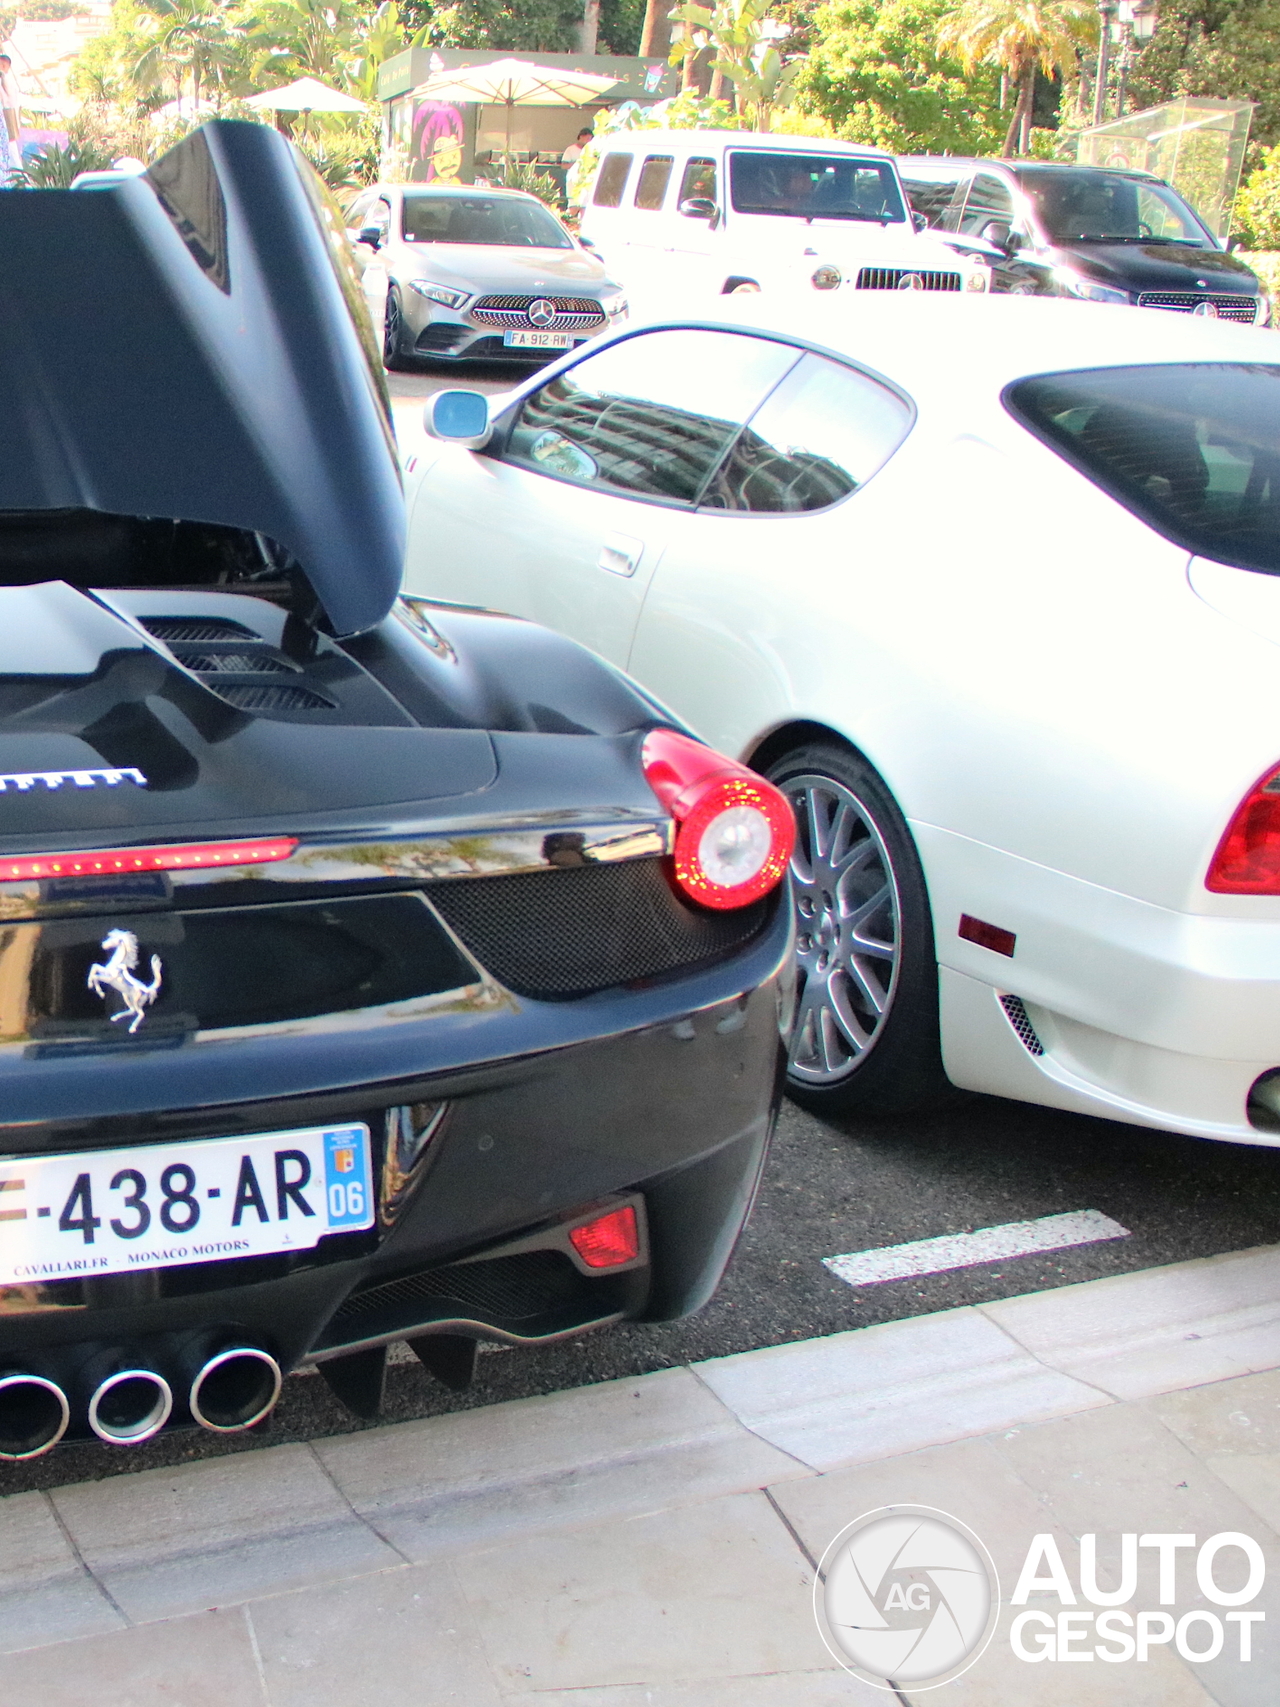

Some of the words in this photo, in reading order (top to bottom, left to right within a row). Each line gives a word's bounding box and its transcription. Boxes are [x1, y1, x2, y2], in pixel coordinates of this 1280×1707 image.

[329, 1181, 364, 1217] 06
[127, 1247, 188, 1264] MONACO
[192, 1239, 250, 1256] MOTORS
